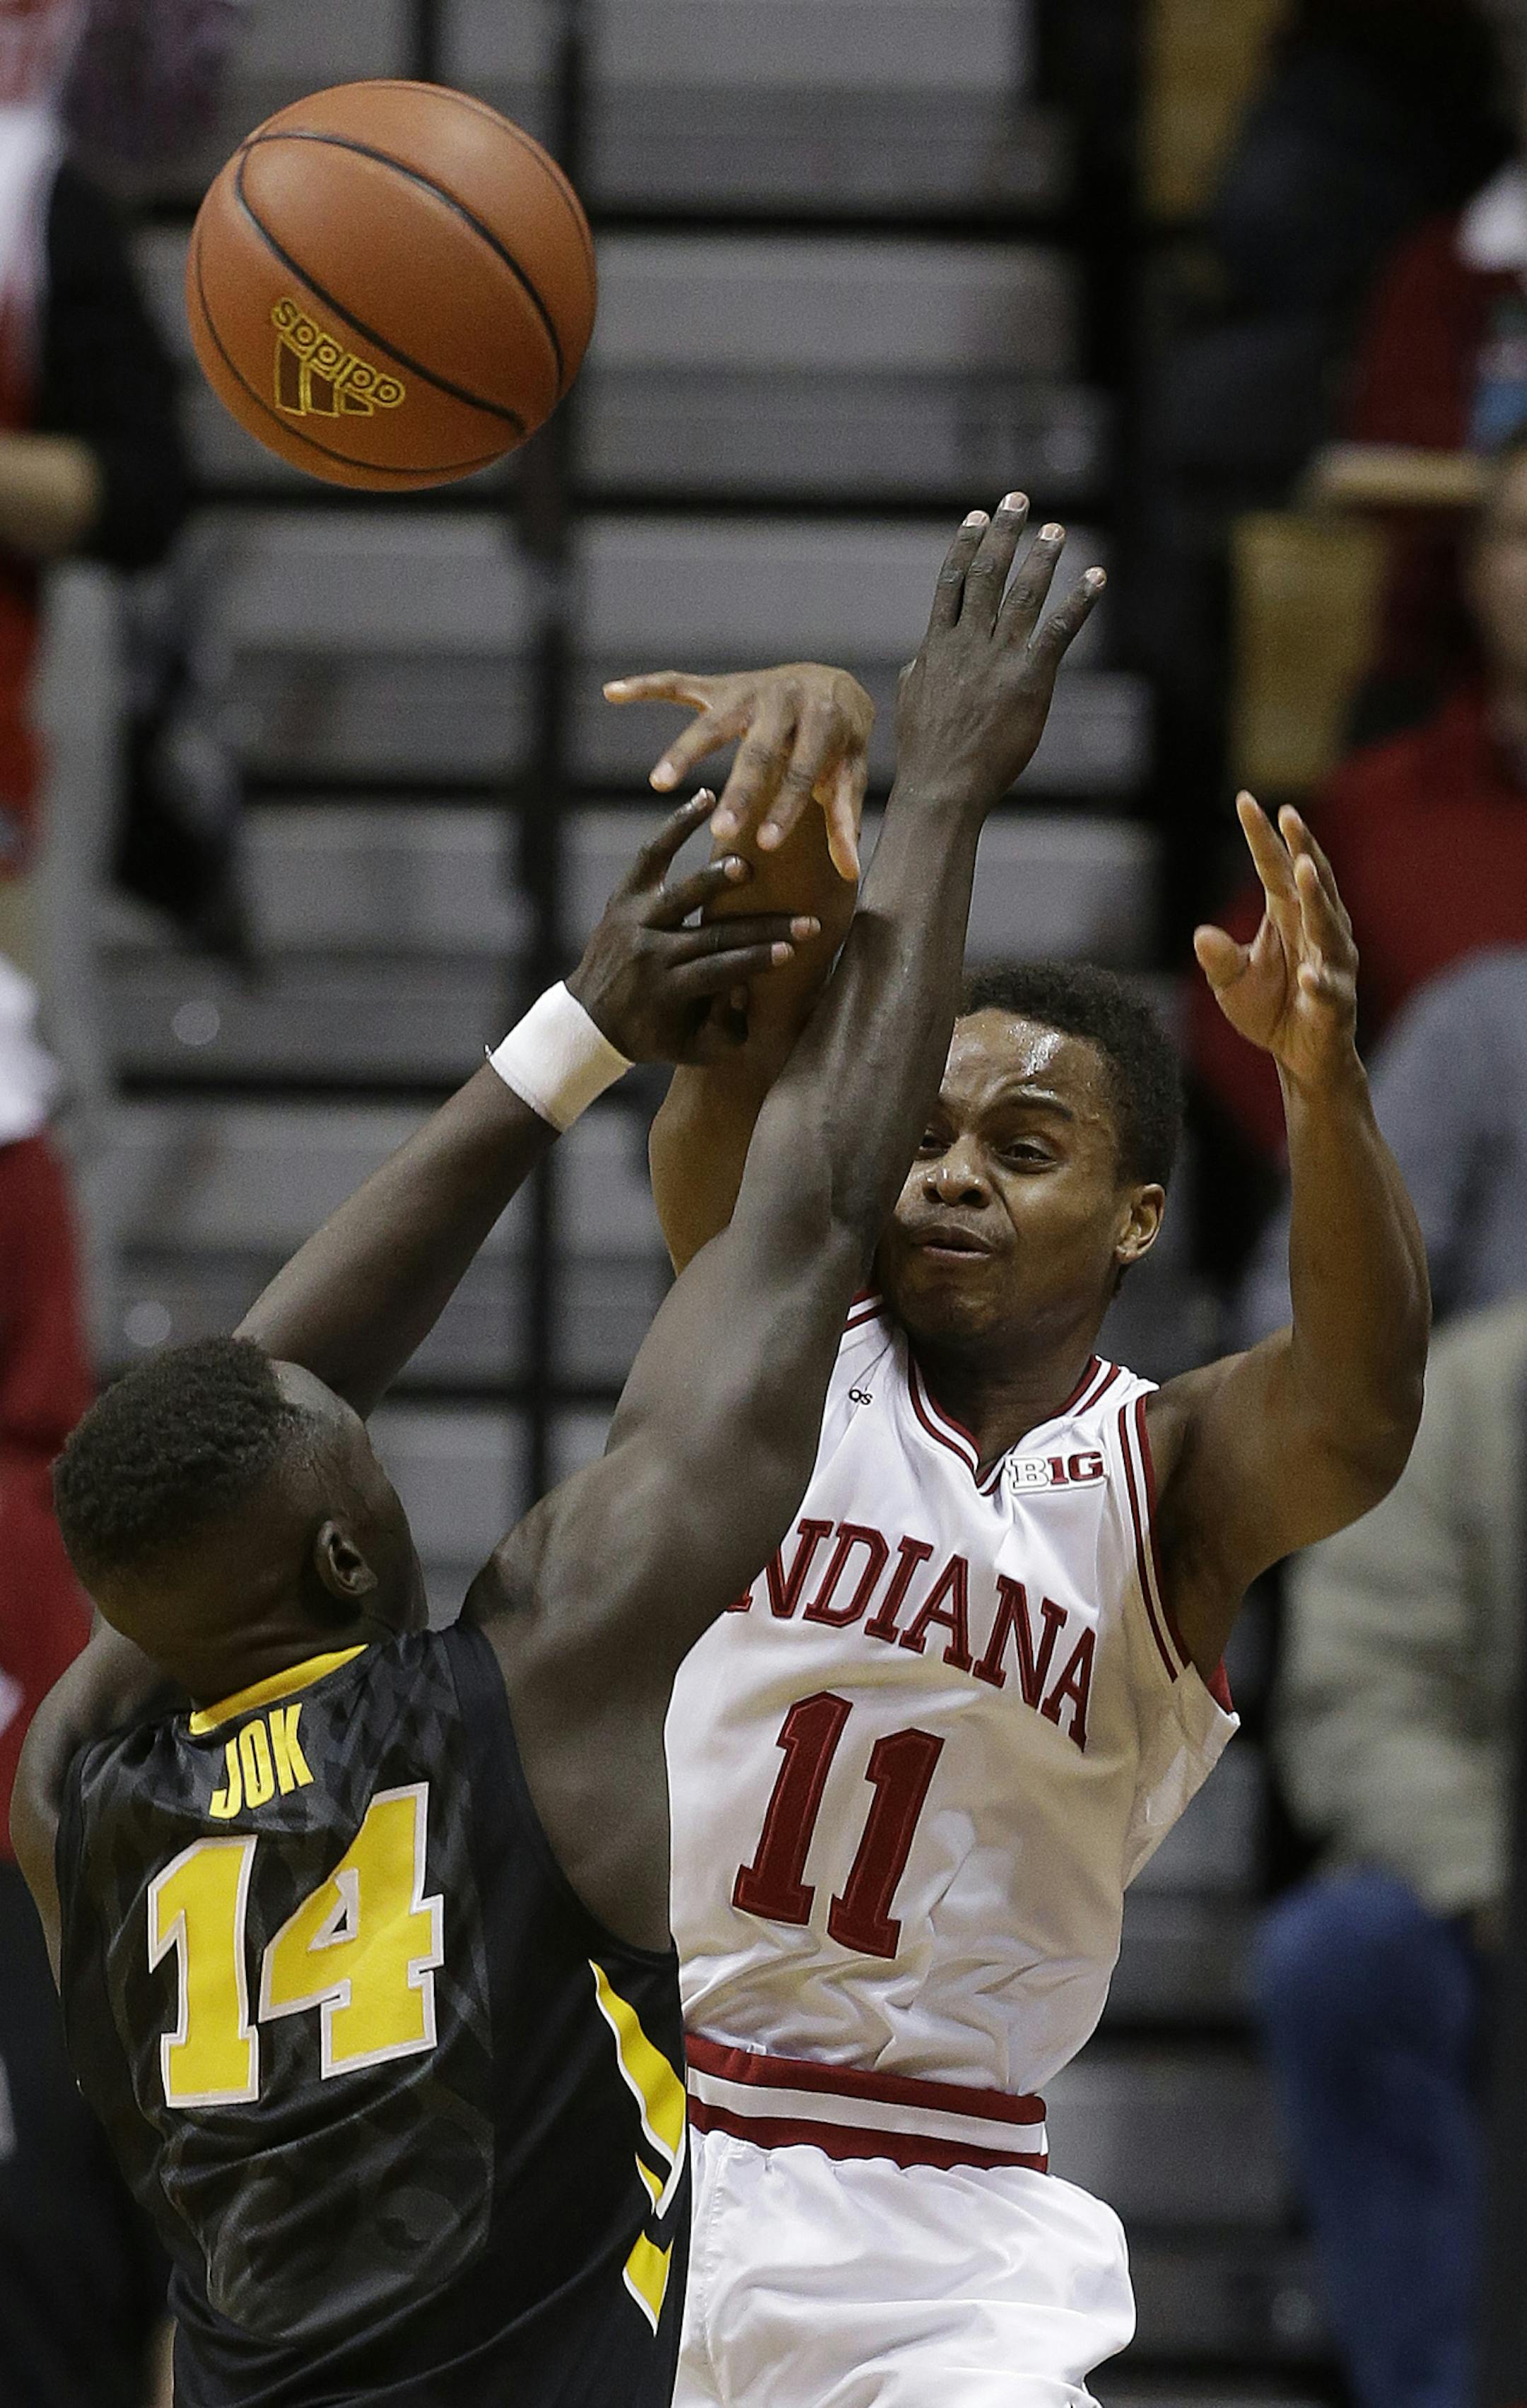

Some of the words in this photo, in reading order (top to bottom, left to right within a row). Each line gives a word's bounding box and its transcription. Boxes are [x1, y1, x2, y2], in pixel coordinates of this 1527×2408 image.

[271, 297, 406, 409] adidas
[726, 1517, 1096, 1754] NDIANA
[209, 1702, 315, 1820] JOK
[732, 1689, 946, 1961] 11
[147, 1780, 444, 2109] 14
